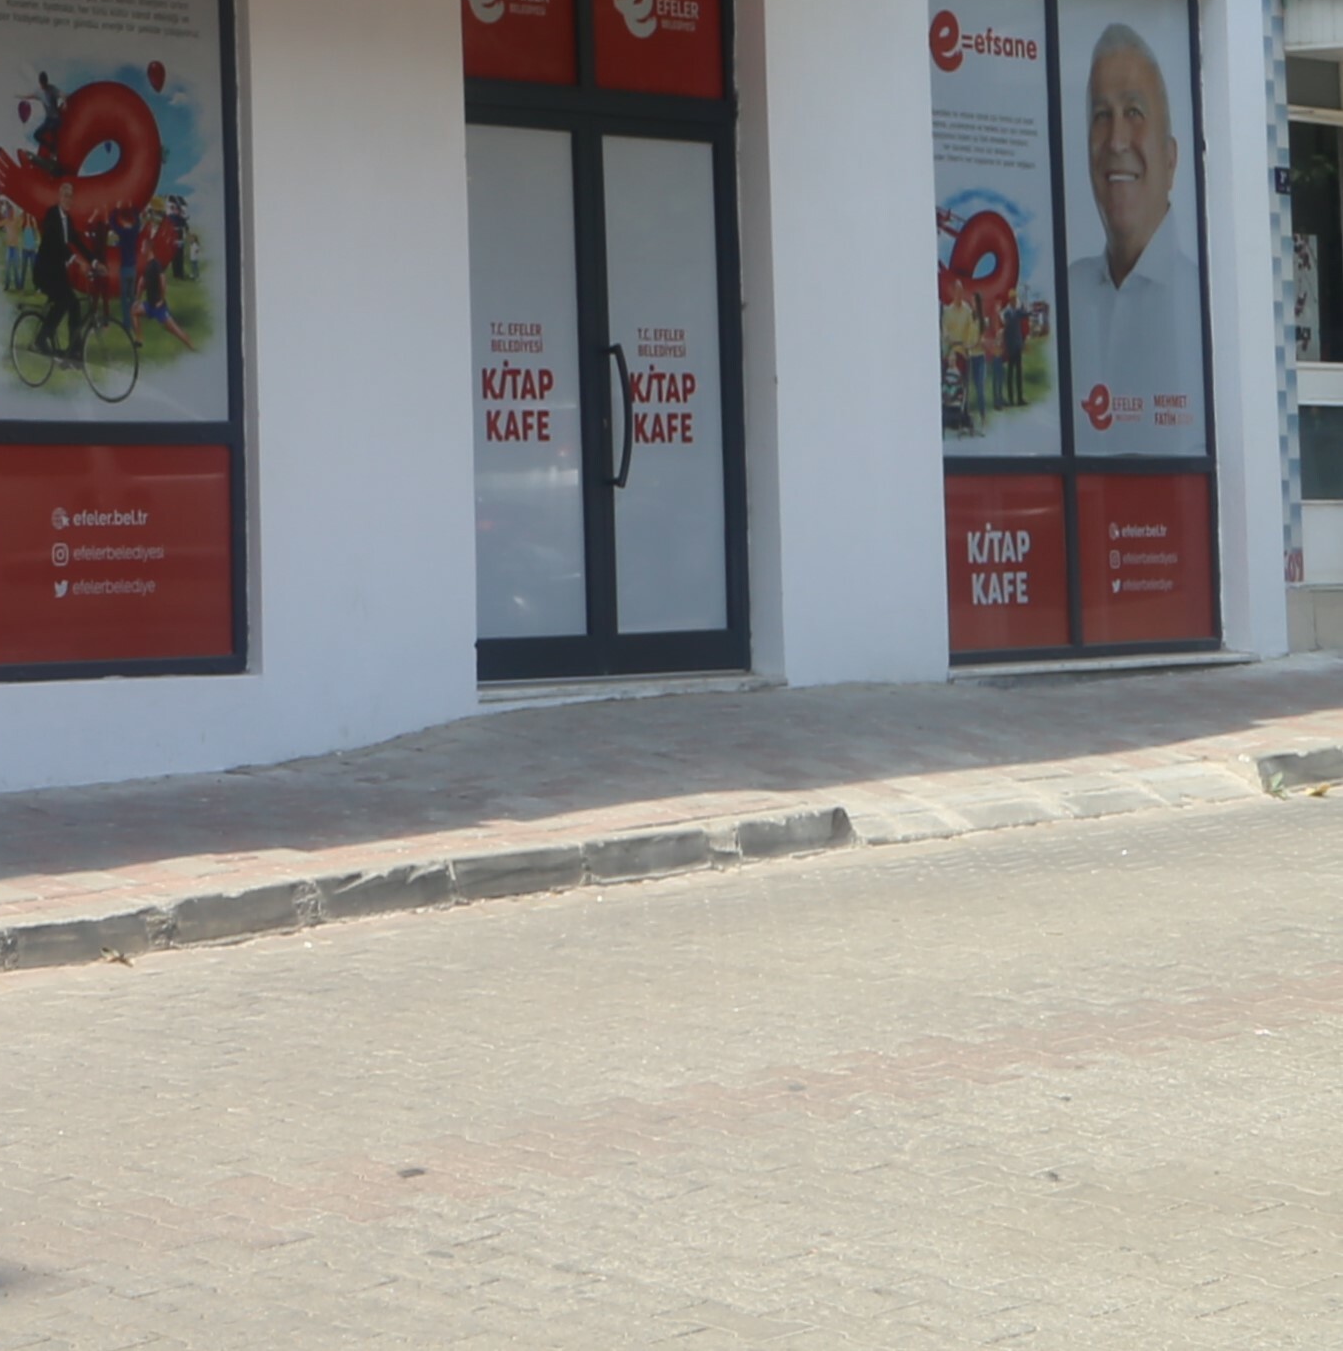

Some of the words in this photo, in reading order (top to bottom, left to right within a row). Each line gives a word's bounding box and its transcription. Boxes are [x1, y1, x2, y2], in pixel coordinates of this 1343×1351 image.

[508, 322, 542, 337] EFELER
[653, 328, 686, 342] EFELER
[481, 359, 554, 401] KİTAP
[629, 364, 696, 404] KİTAP
[486, 409, 551, 442] KAFE
[633, 412, 694, 444] KAFE
[72, 507, 149, 527] efeler.bel.tr
[966, 521, 1031, 565] KİTAP
[971, 570, 1030, 606] KAFE
